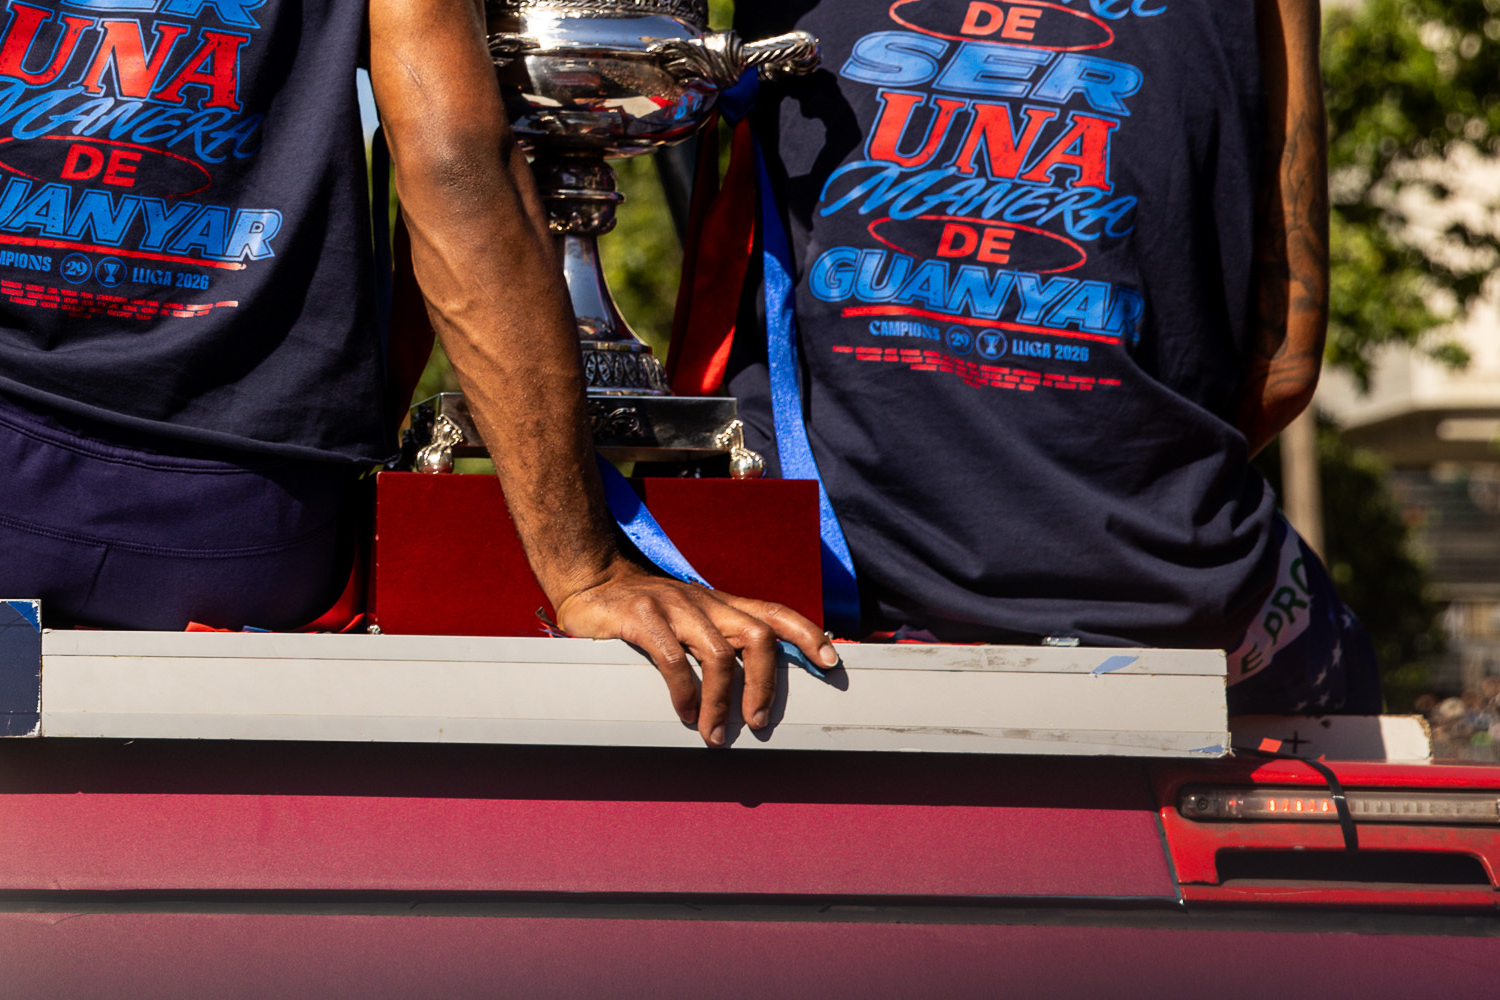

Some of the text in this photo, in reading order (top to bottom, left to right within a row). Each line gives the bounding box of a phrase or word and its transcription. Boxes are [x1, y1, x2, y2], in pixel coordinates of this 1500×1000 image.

[960, 1, 1042, 41] DE
[839, 31, 1143, 116] SER
[864, 88, 1120, 195] UNA
[61, 143, 142, 187] DE
[936, 223, 1015, 264] DE
[64, 260, 88, 277] 29
[132, 267, 171, 286] LLIGA
[175, 272, 209, 290] 2026
[809, 246, 1144, 342] GUANYAR
[869, 320, 1090, 362] CAMPIONS 29 LLIGA 2026
